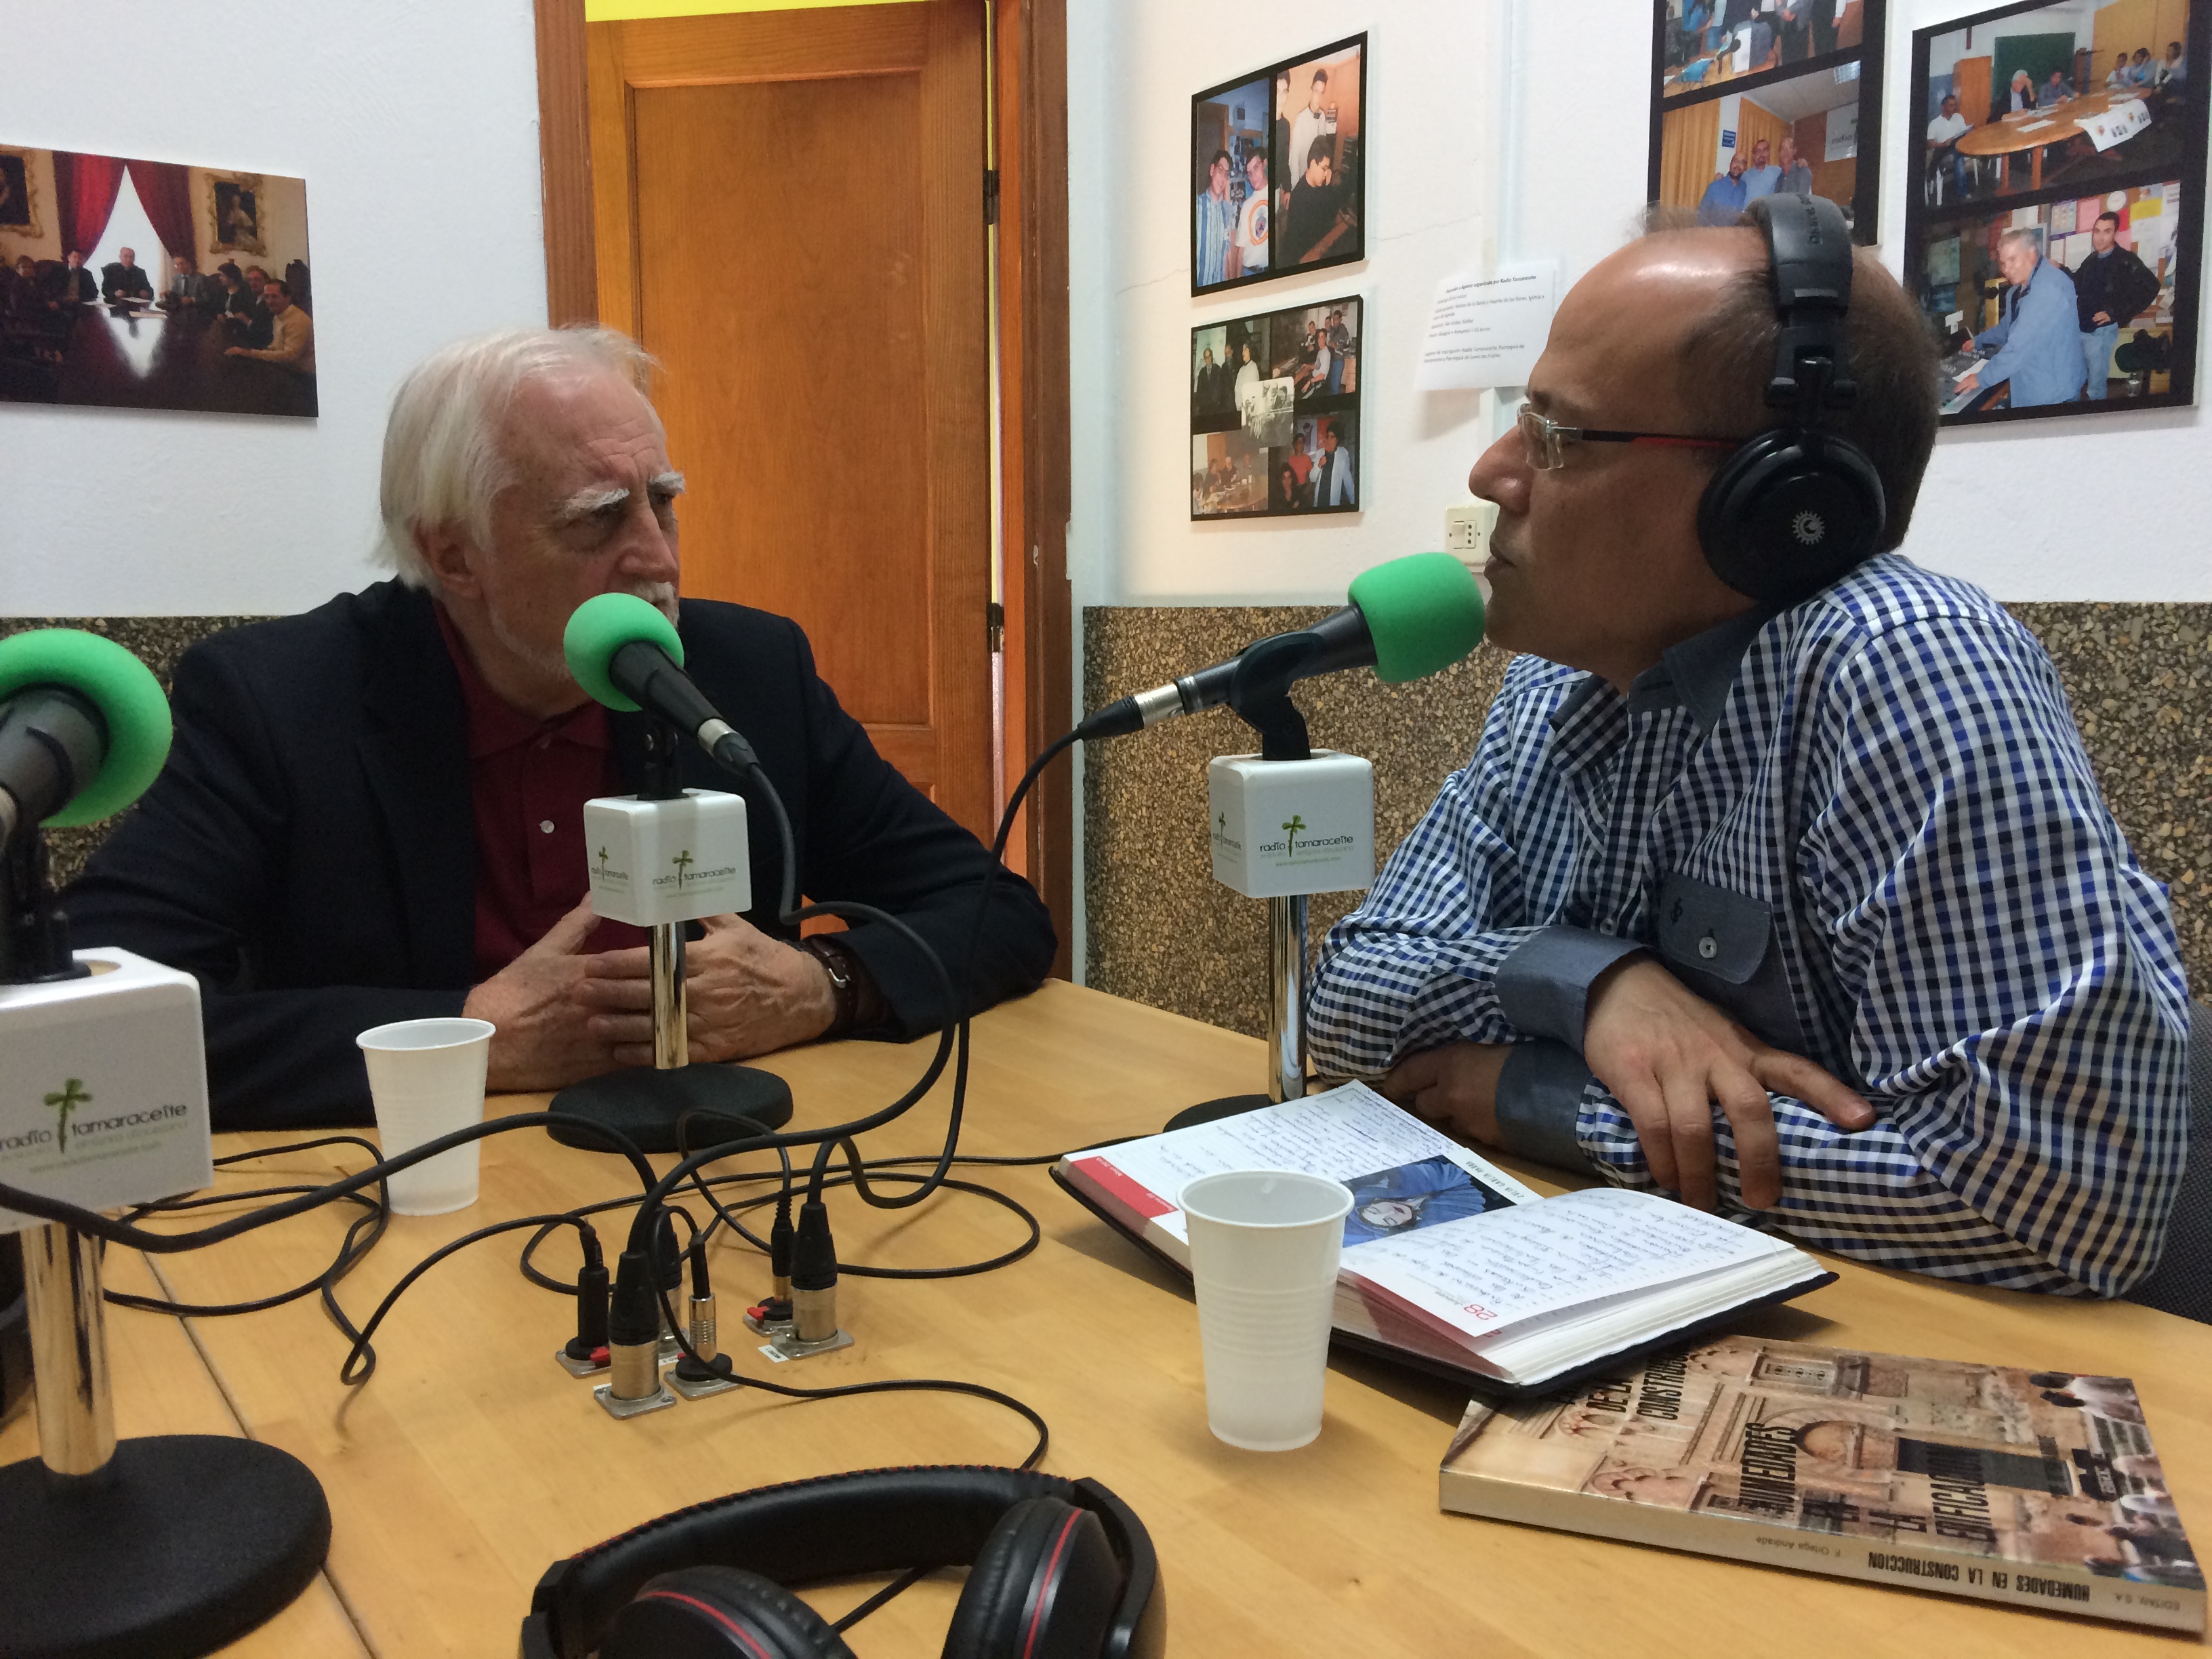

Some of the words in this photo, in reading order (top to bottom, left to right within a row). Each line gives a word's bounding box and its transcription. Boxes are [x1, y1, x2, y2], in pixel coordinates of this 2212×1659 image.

[1259, 842, 1286, 852] radio
[1294, 835, 1354, 848] tamaraceite
[653, 875, 676, 885] radio
[684, 867, 737, 880] tamaraceite
[0, 1128, 52, 1150] radio
[71, 1103, 188, 1136] tamaraceite
[1463, 1304, 1498, 1320] 28
[1586, 1393, 1629, 1413] DE
[1738, 1422, 1797, 1512] HUMEDADES
[1755, 1536, 1795, 1550] Andrade
[1868, 1551, 1959, 1582] CONSTRUCCION
[1967, 1566, 1983, 1586] LA
[1992, 1571, 2008, 1589] EN
[2016, 1574, 2090, 1602] HUMEDADES
